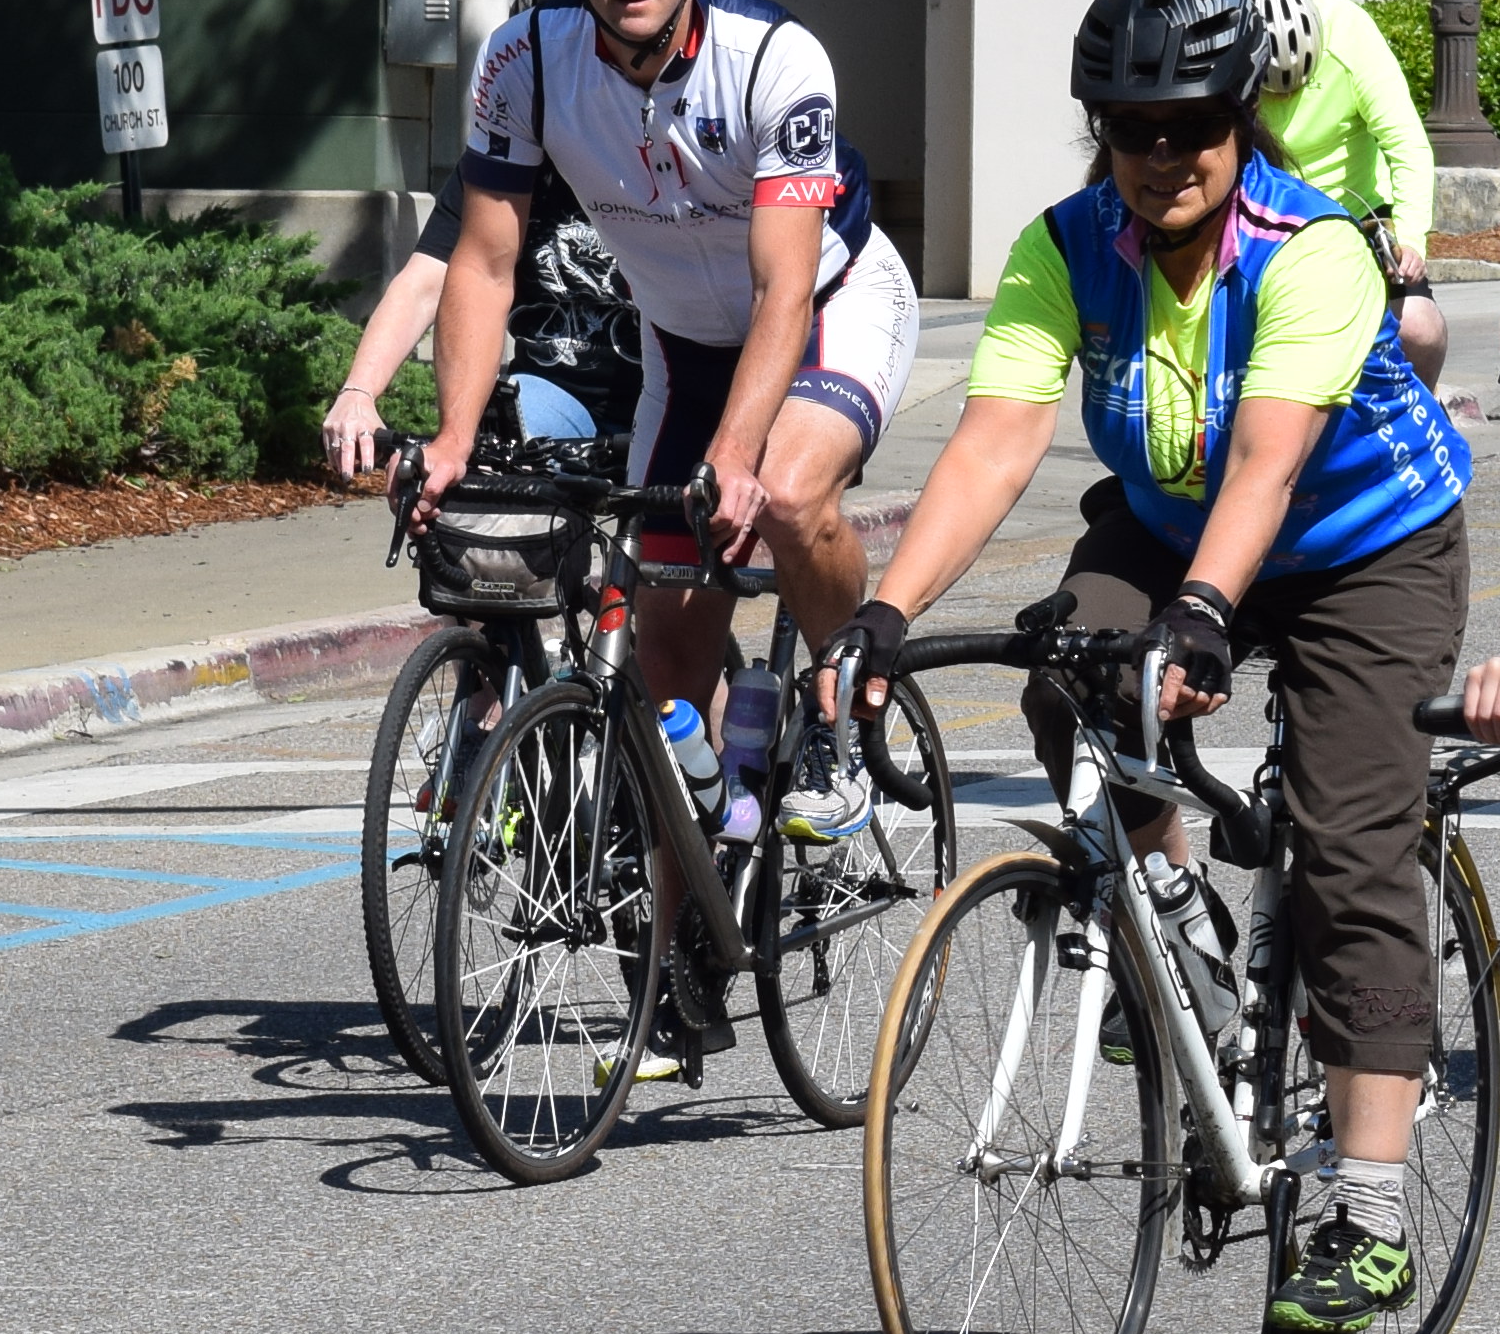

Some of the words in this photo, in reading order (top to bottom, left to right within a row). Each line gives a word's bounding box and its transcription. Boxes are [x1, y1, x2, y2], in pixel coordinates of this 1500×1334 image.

[113, 60, 145, 95] 100
[474, 31, 532, 122] PHARMA
[104, 112, 143, 134] CHURCH
[147, 109, 164, 128] ST.
[777, 182, 827, 202] AW
